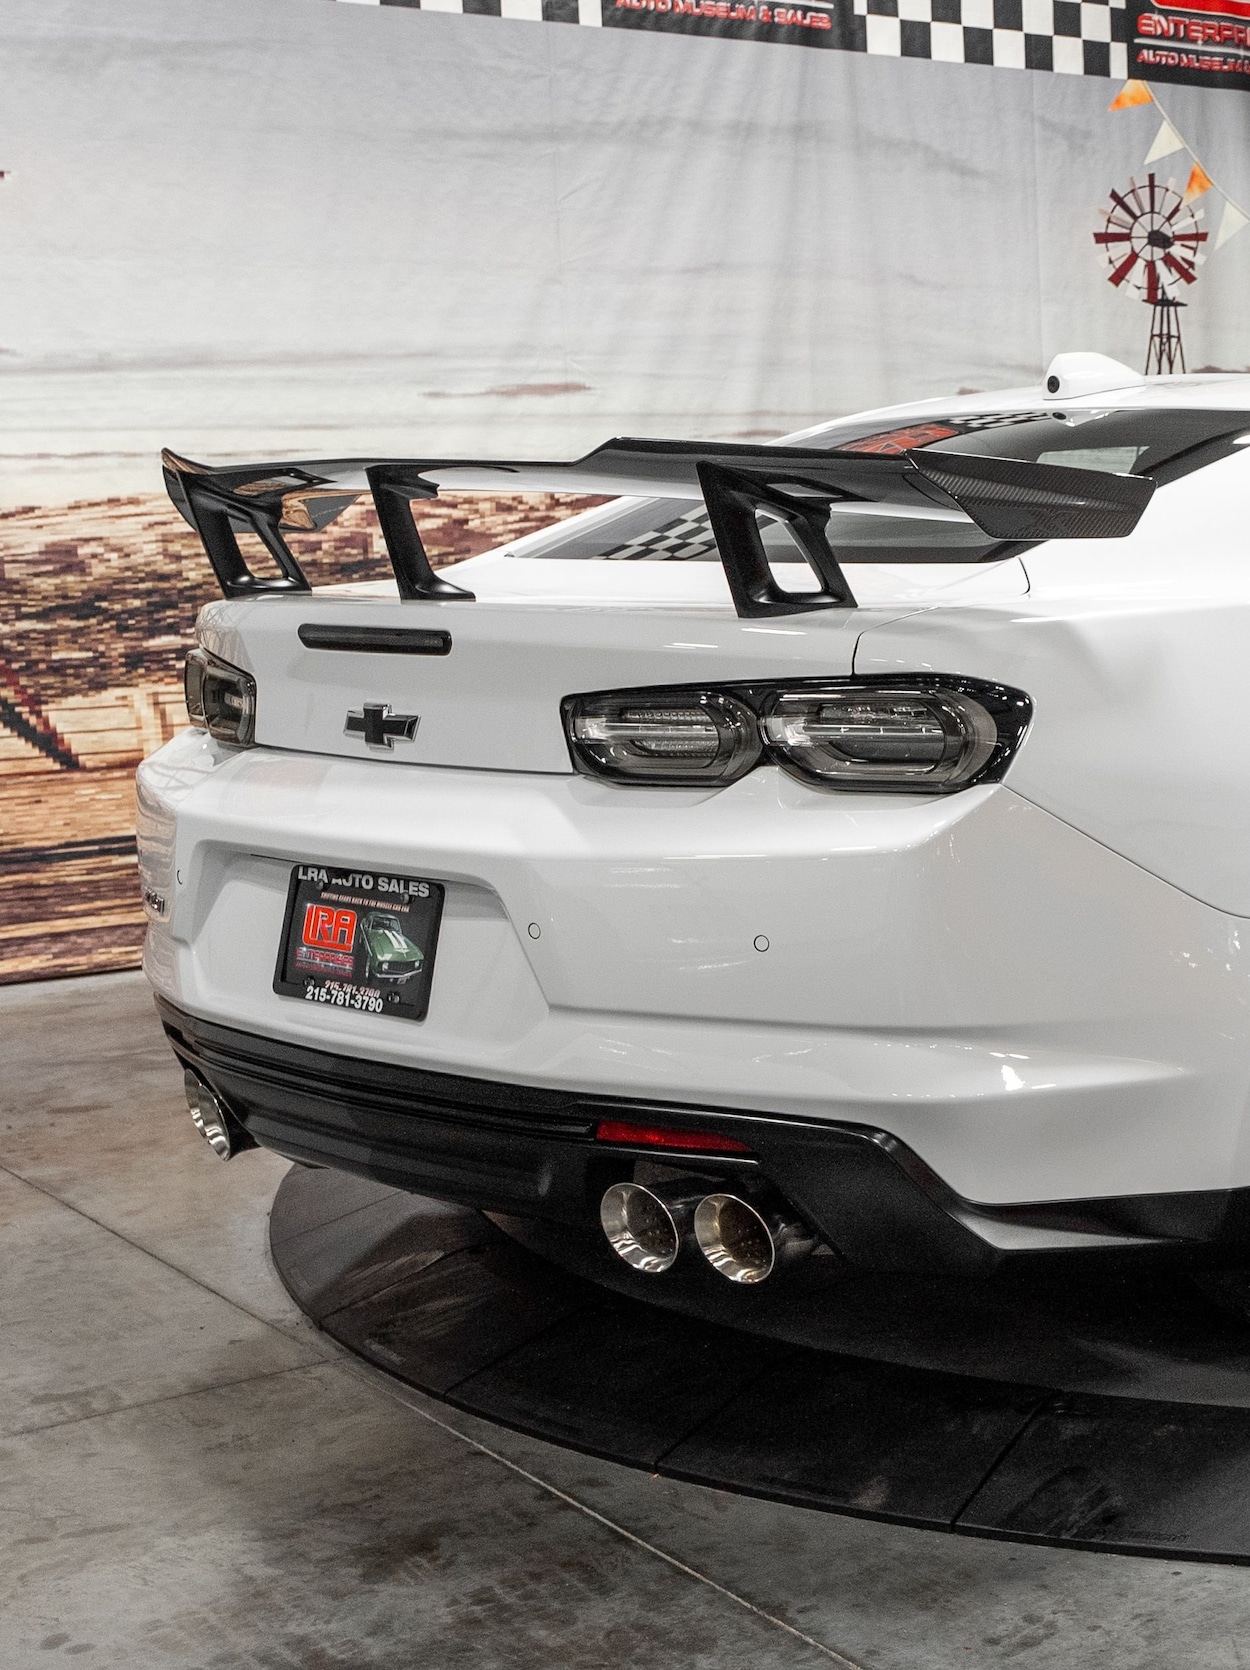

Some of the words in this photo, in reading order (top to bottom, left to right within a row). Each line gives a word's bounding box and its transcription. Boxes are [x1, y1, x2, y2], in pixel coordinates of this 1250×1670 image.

[614, 0, 672, 13] AUTO
[673, 0, 757, 22] MUSEUM
[758, 5, 773, 23] &
[774, 8, 832, 30] SALES
[1136, 49, 1179, 66] AUTO
[298, 866, 328, 884] LRA
[332, 873, 374, 890] AUTO
[378, 876, 430, 897] SALES
[303, 904, 357, 953] LRA
[305, 985, 384, 1013] 215-781-3790
